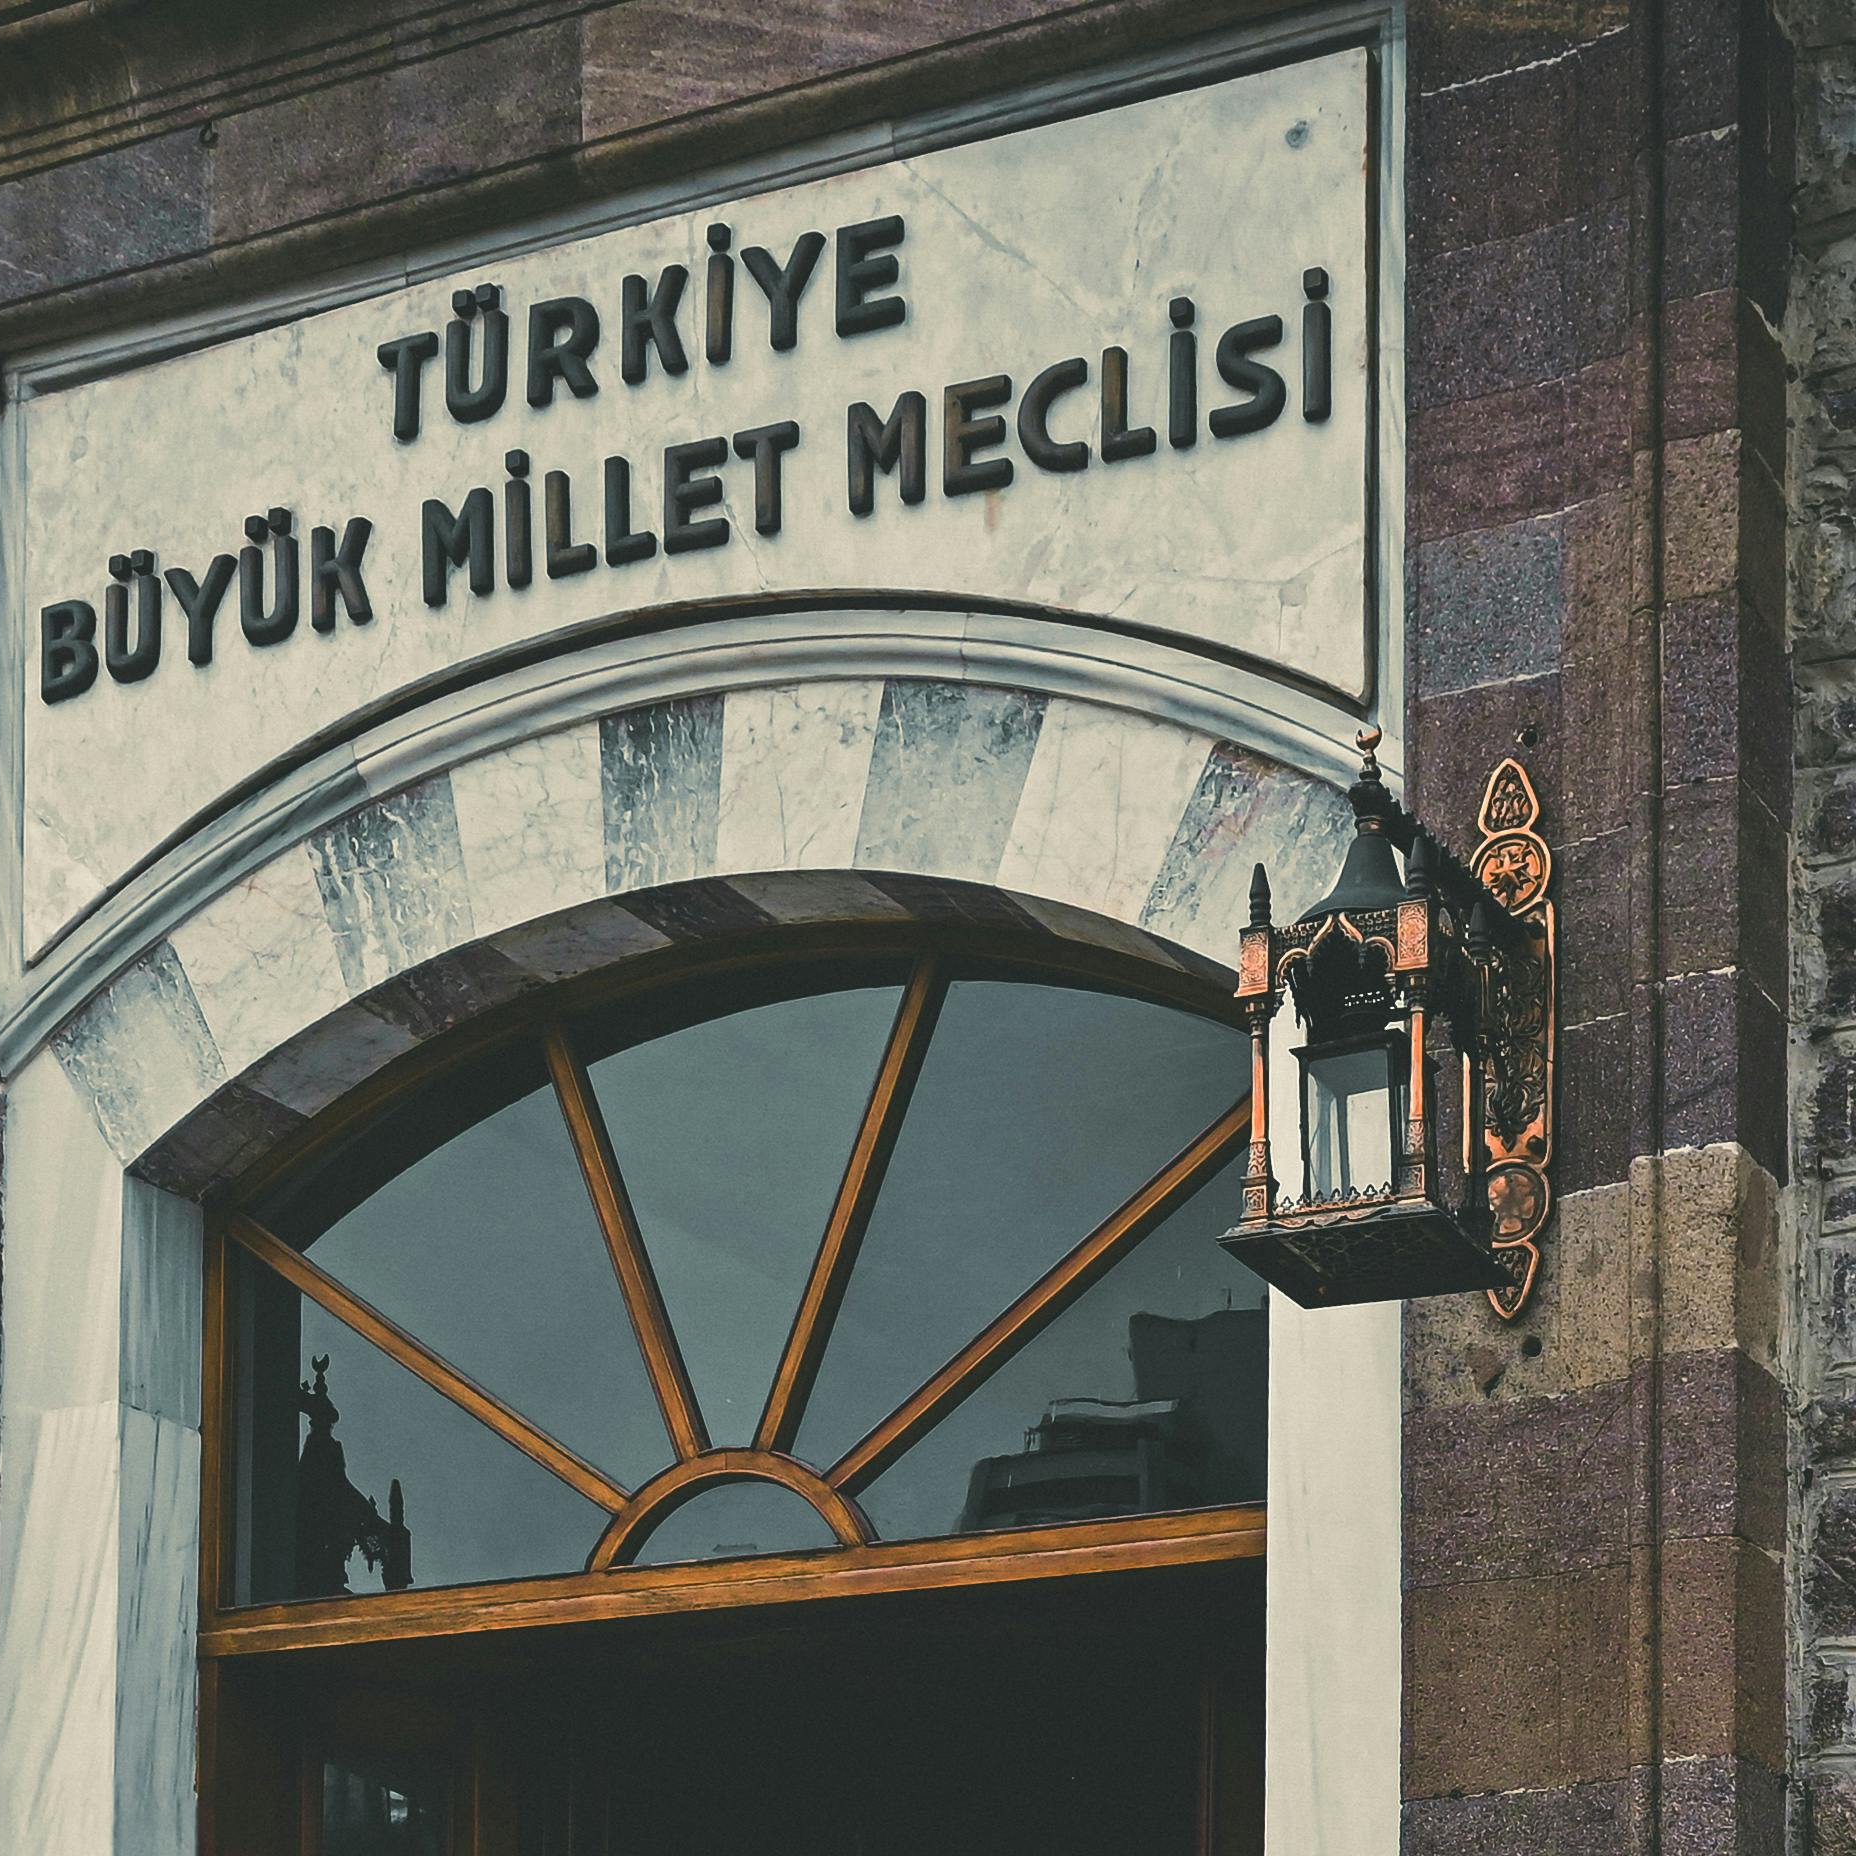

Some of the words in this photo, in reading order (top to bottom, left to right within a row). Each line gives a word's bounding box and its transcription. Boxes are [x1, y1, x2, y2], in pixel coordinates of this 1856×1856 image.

[39, 505, 375, 706] BÜYÜK
[420, 419, 801, 610] MİLLET
[846, 265, 1333, 519] MECLİSİ
[375, 213, 907, 446] TÜRKİYE
